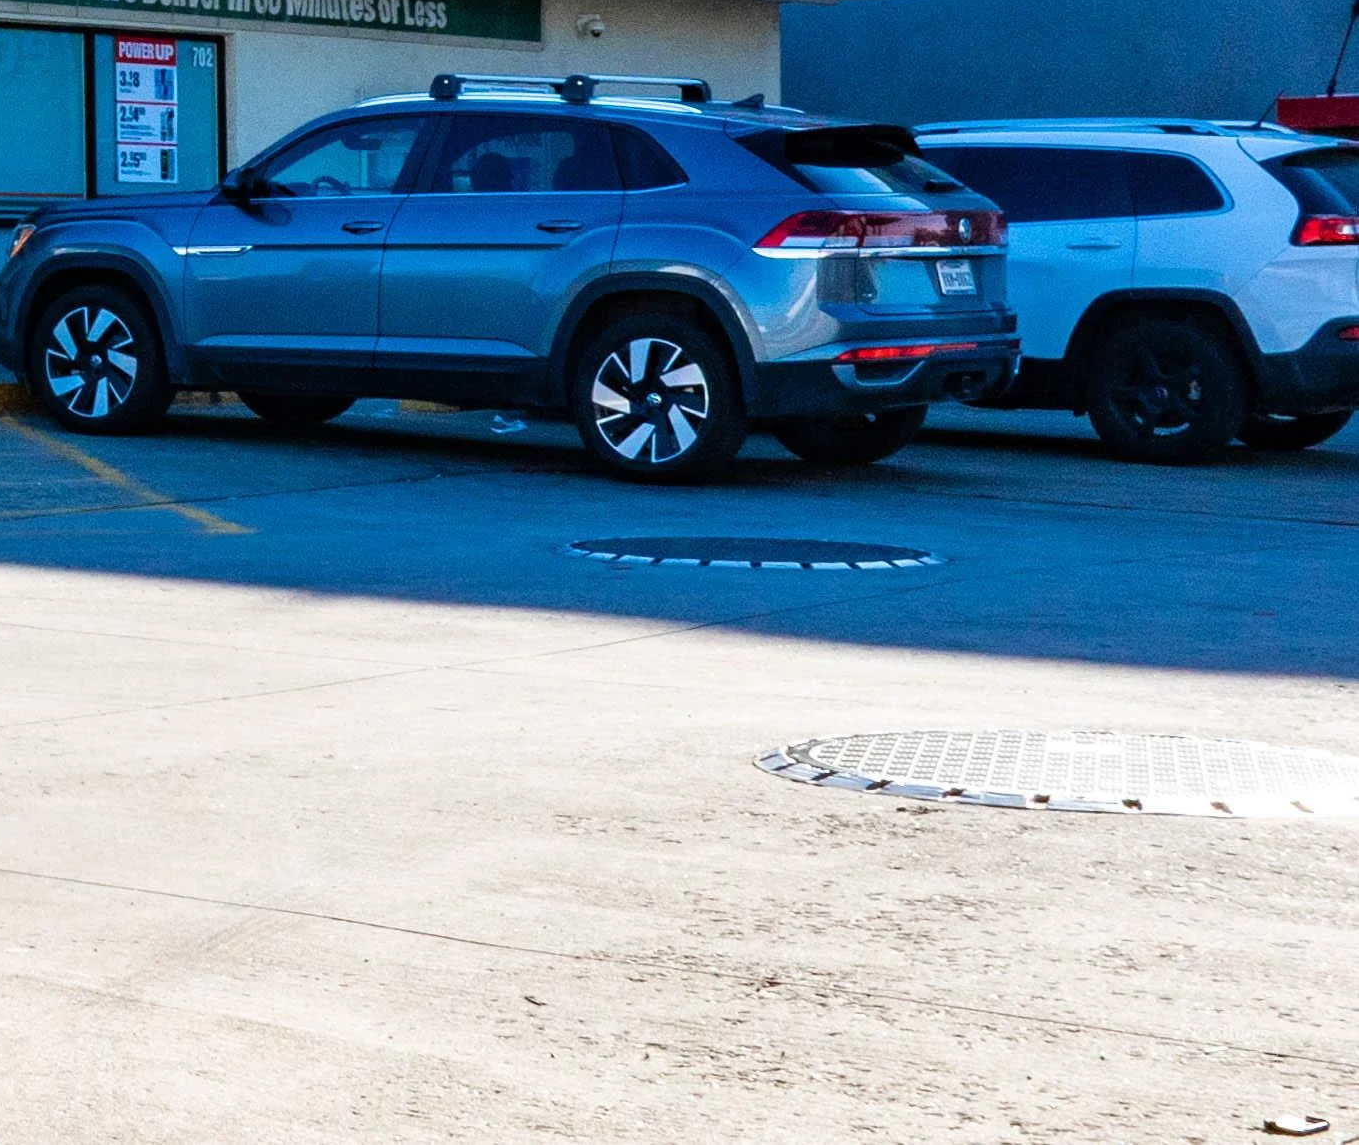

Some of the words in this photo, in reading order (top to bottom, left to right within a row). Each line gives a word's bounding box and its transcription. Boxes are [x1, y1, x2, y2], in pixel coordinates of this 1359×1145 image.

[118, 41, 154, 59] POWER
[155, 44, 174, 60] UP
[192, 46, 214, 67] 702
